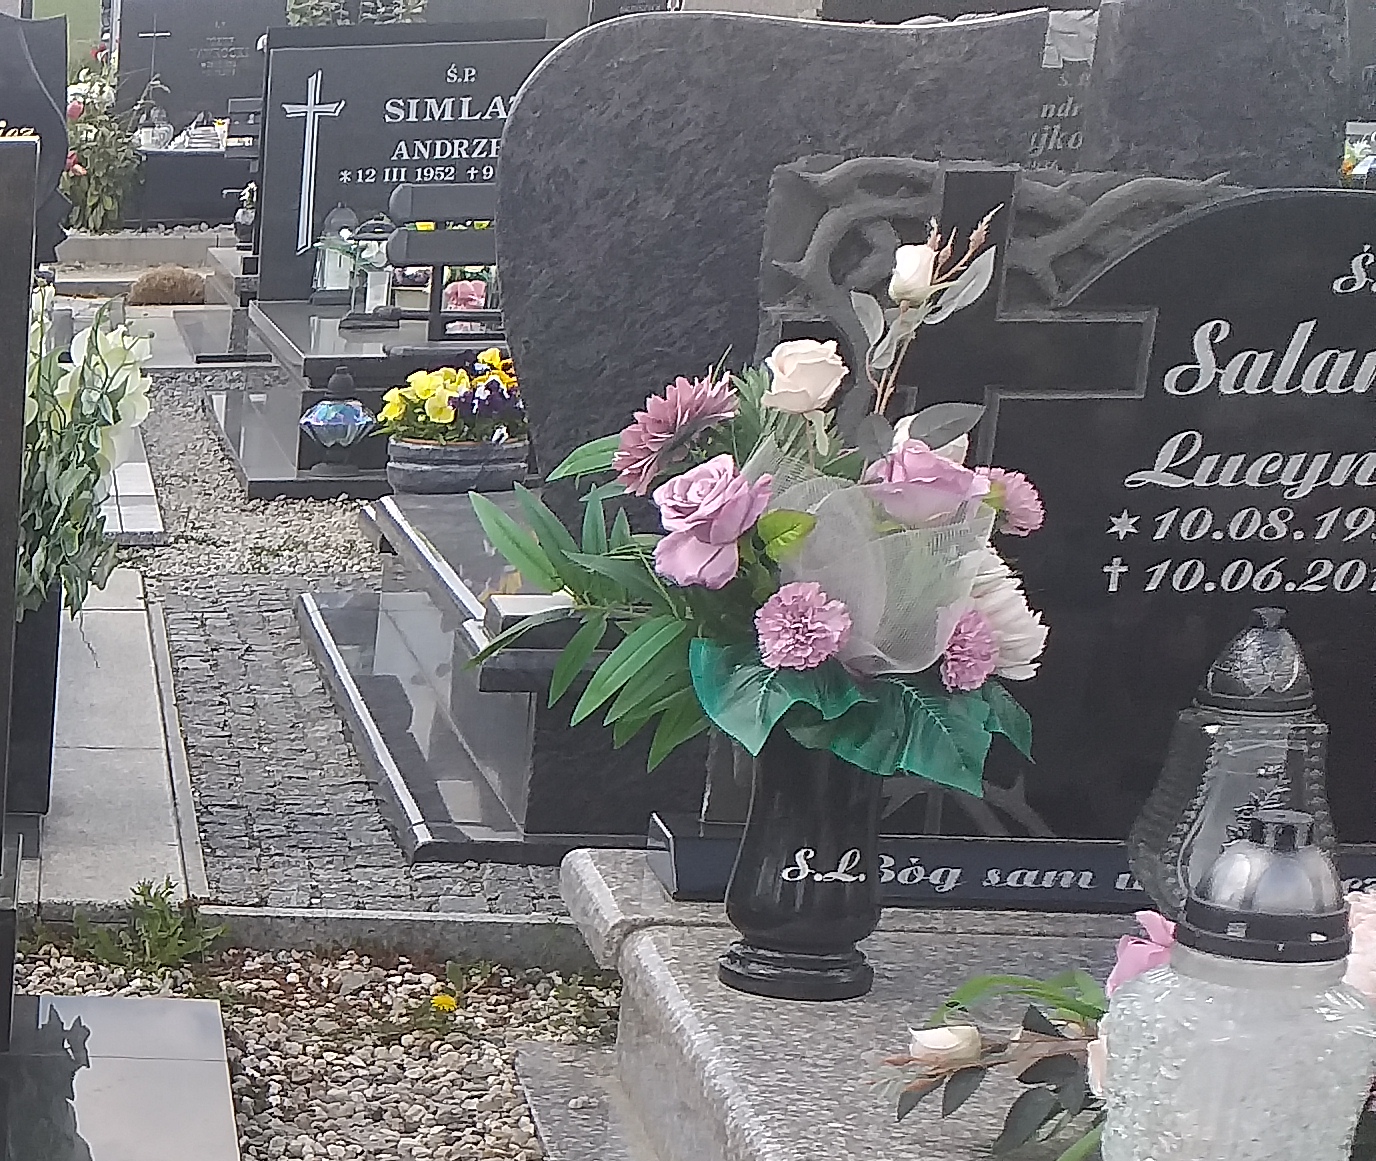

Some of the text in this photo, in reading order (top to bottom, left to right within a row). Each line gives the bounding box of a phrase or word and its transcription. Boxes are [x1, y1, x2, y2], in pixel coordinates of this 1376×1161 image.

[446, 63, 477, 83] Ś.P.
[384, 95, 518, 122] SIMLA
[356, 165, 495, 183] 12 III 1952 9
[1152, 506, 1376, 542] 10.08.19
[1143, 557, 1376, 593] 10.06.20
[982, 868, 1099, 889] sam
